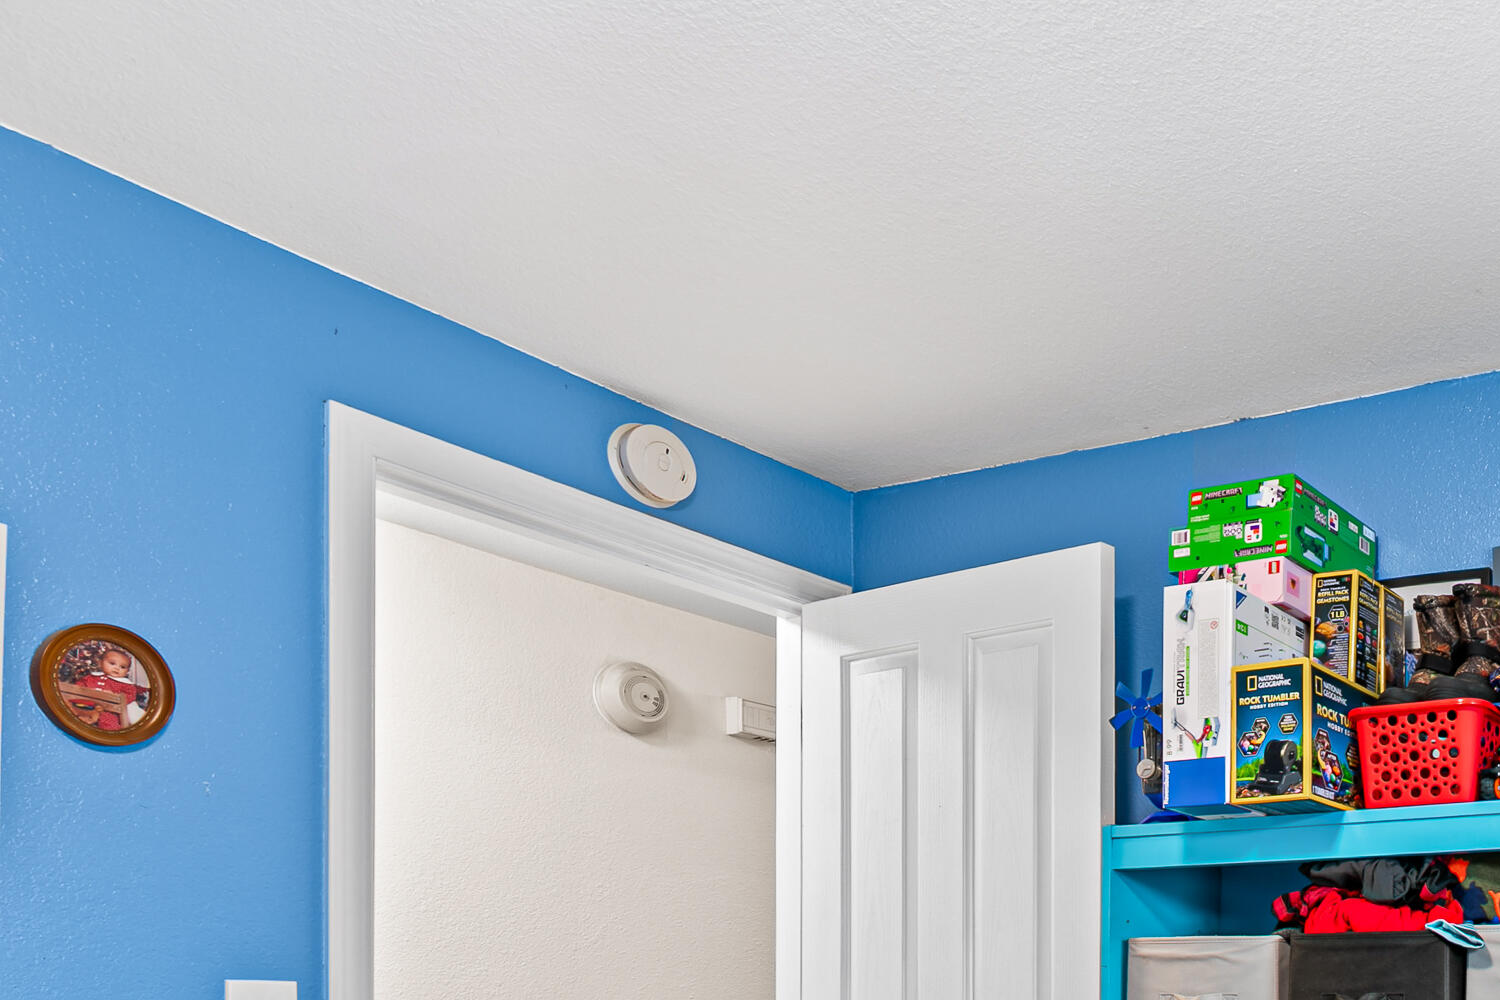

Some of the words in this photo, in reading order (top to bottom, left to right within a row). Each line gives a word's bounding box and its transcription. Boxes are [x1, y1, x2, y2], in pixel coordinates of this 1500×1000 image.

[1204, 487, 1243, 500] MINECRAFT
[1258, 673, 1284, 682] NATIONAL
[1258, 679, 1291, 689] GEOGRAPHIC
[1323, 681, 1343, 697] NATIONAL
[1239, 695, 1261, 706] ROCK
[1262, 692, 1300, 702] TUMBLER
[1323, 688, 1348, 707] GEOGRAPHIC
[1316, 703, 1338, 723] ROCK
[1327, 722, 1344, 733] HOBBY
